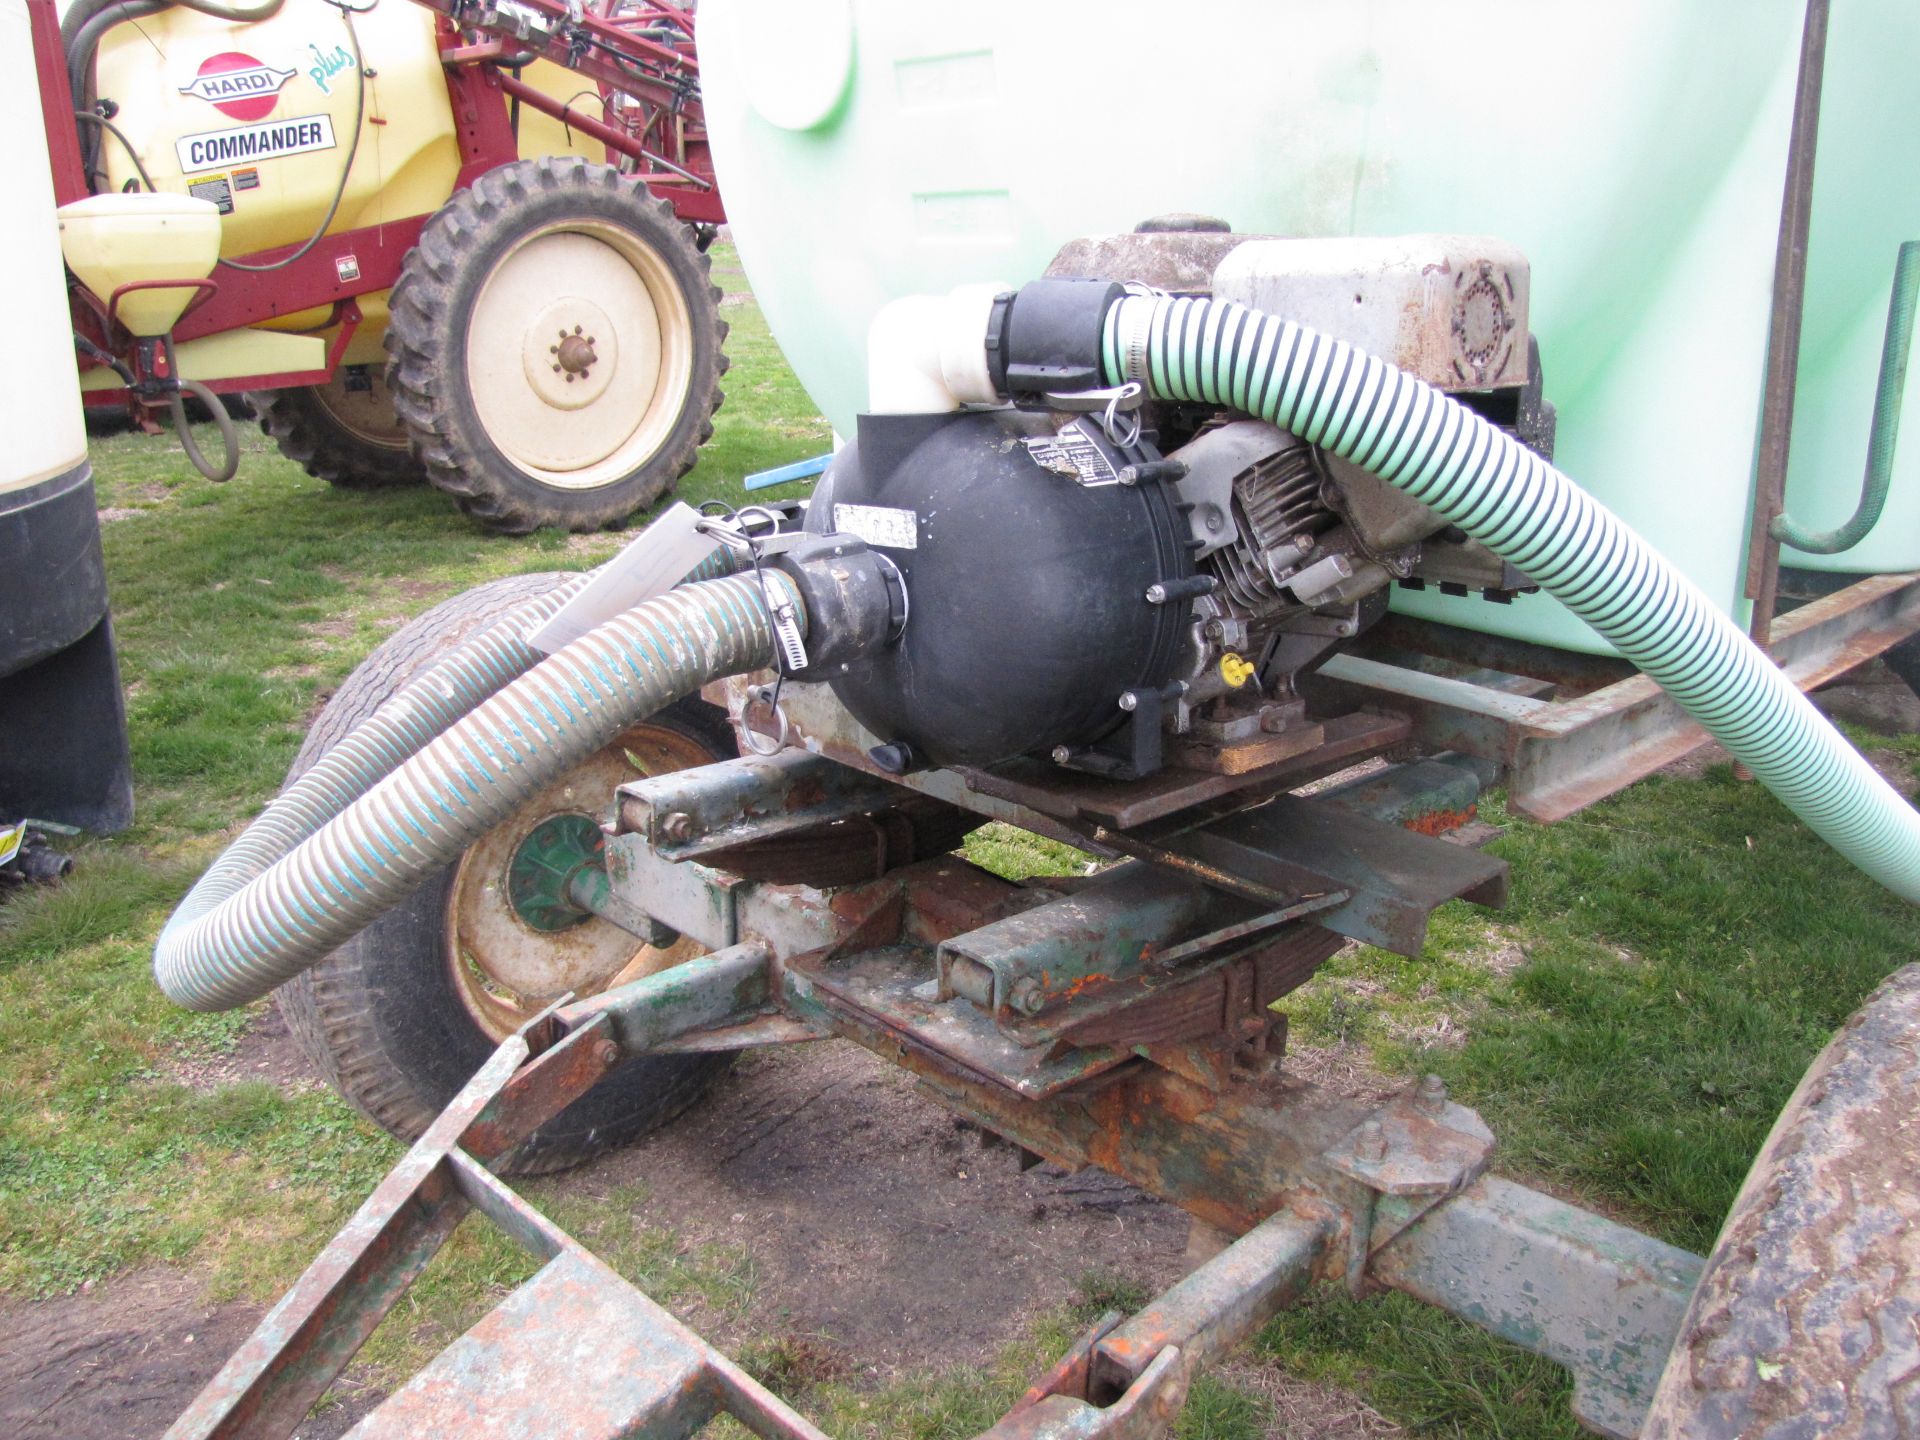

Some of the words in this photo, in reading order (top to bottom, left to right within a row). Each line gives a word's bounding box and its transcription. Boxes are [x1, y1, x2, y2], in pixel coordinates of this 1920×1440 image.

[202, 73, 275, 97] HARDI
[309, 43, 354, 94] plus
[190, 122, 323, 165] COMMANDER
